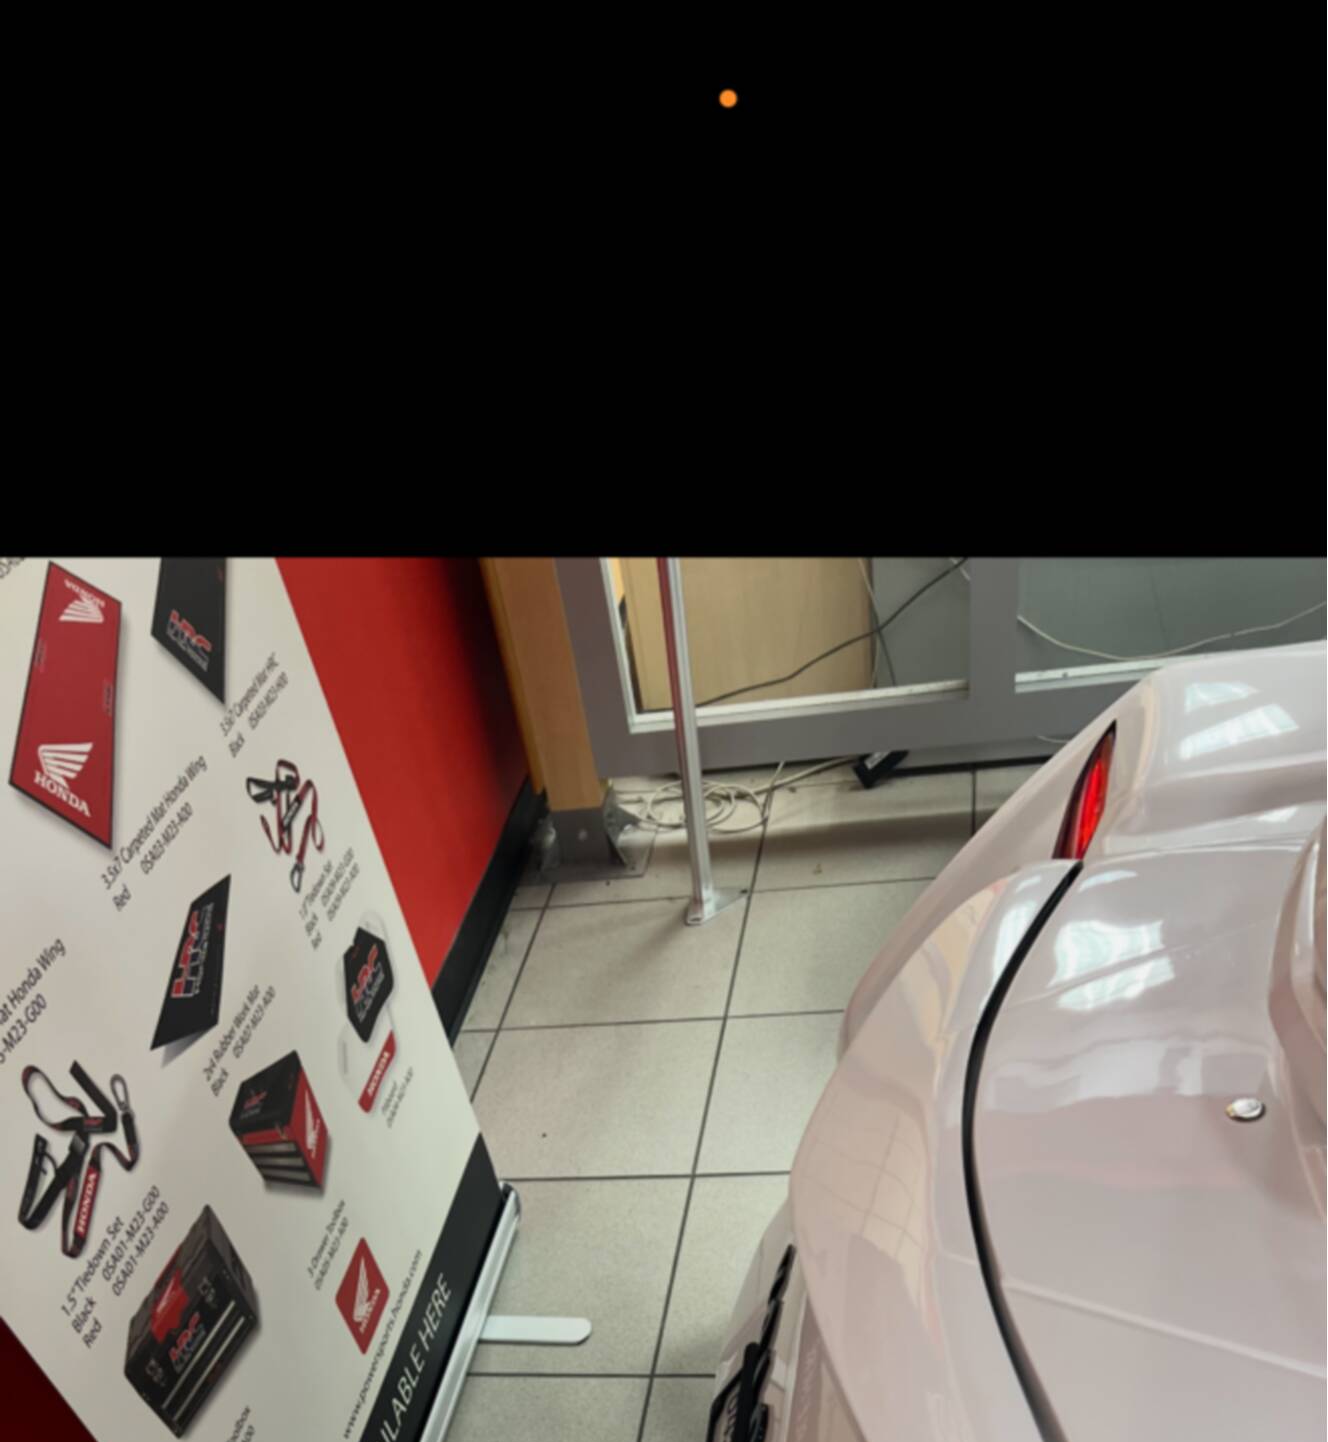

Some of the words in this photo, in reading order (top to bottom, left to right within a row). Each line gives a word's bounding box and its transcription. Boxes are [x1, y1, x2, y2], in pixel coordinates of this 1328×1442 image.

[33, 770, 91, 818] HONDA
[162, 775, 189, 808] Honda
[7, 966, 43, 1010] Honda
[36, 938, 67, 972] Wing
[77, 1172, 98, 1234] HONDA
[106, 1216, 124, 1242] Set
[71, 1296, 96, 1334] Black
[82, 1317, 103, 1349] Red
[418, 1272, 453, 1352] HERE
